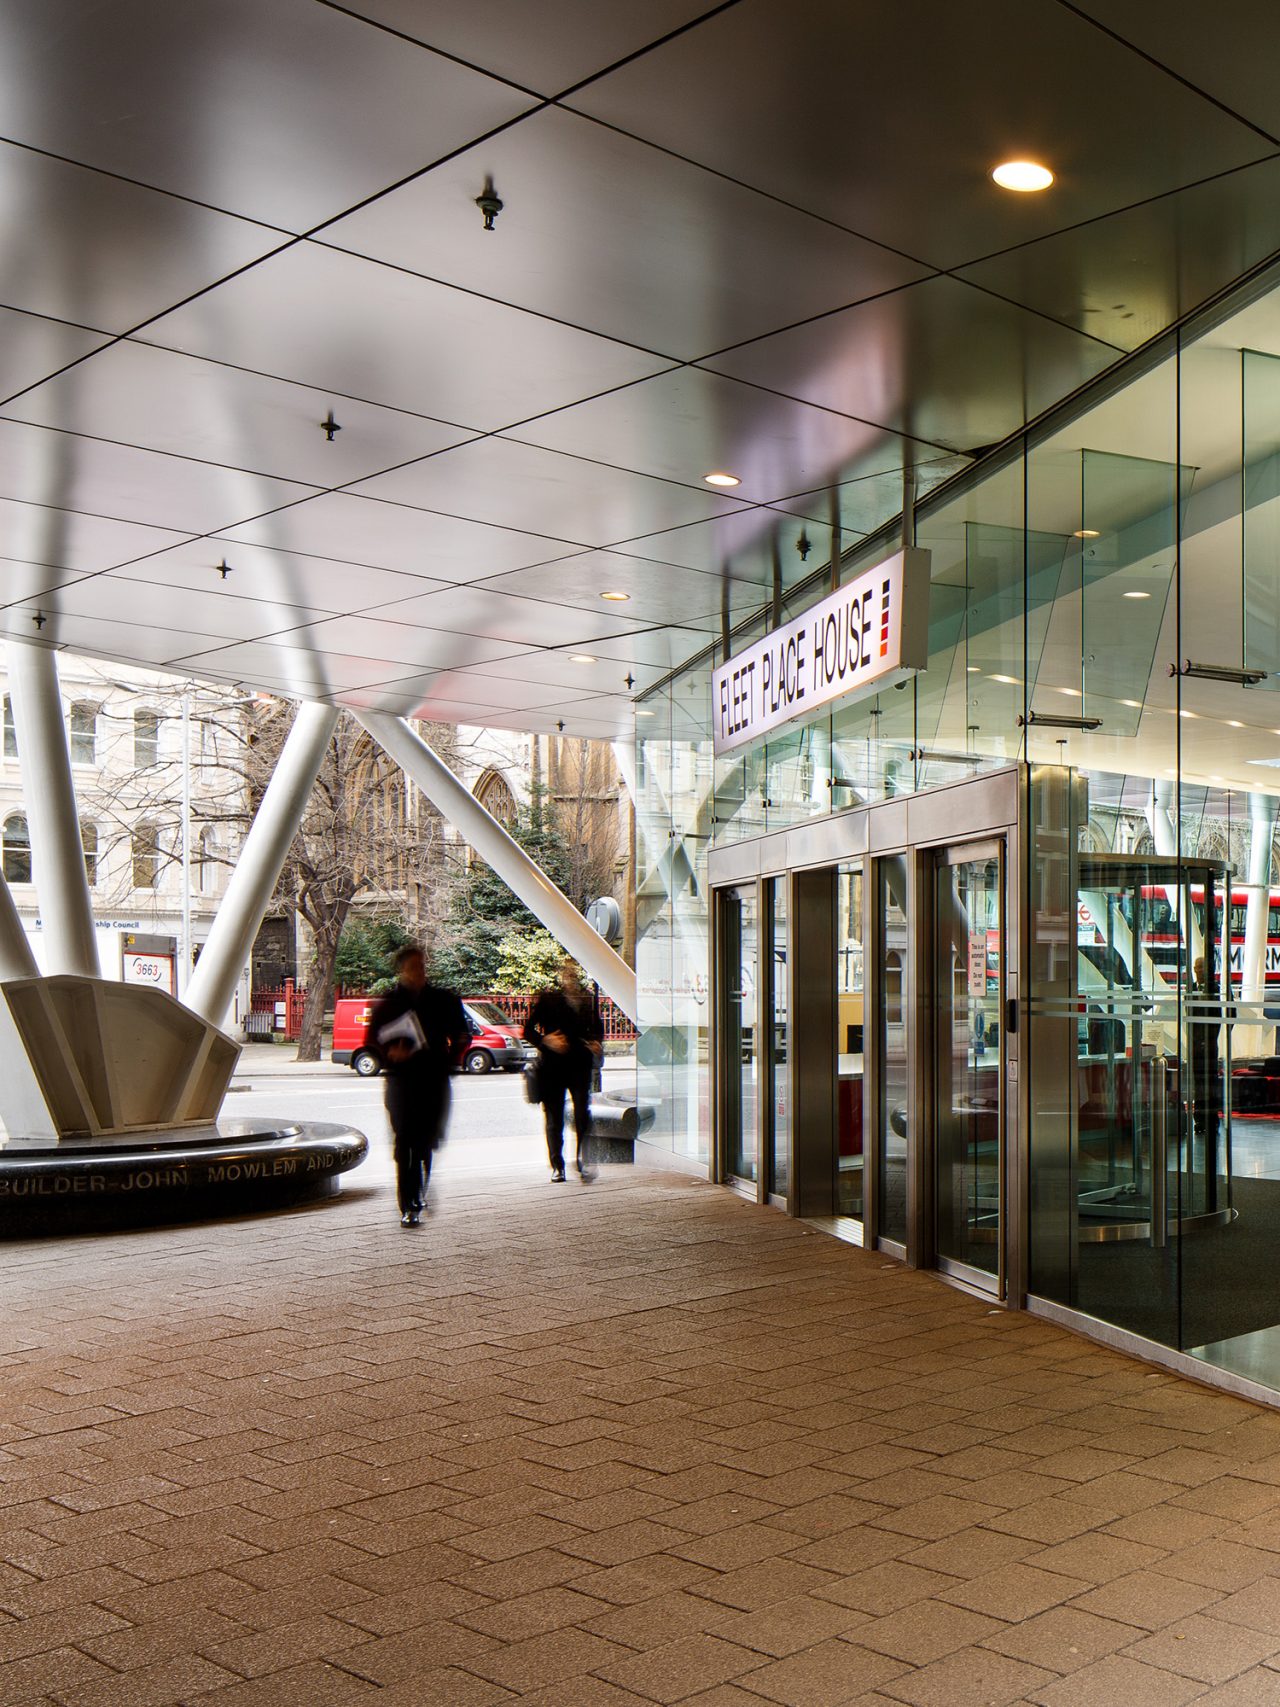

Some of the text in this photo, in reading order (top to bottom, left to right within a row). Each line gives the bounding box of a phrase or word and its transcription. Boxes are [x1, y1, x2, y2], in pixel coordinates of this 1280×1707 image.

[720, 589, 873, 739] FLEET PLACE HOUSE
[136, 963, 158, 976] 3663
[208, 1160, 297, 1183] MOWLEM
[307, 1153, 334, 1172] AND
